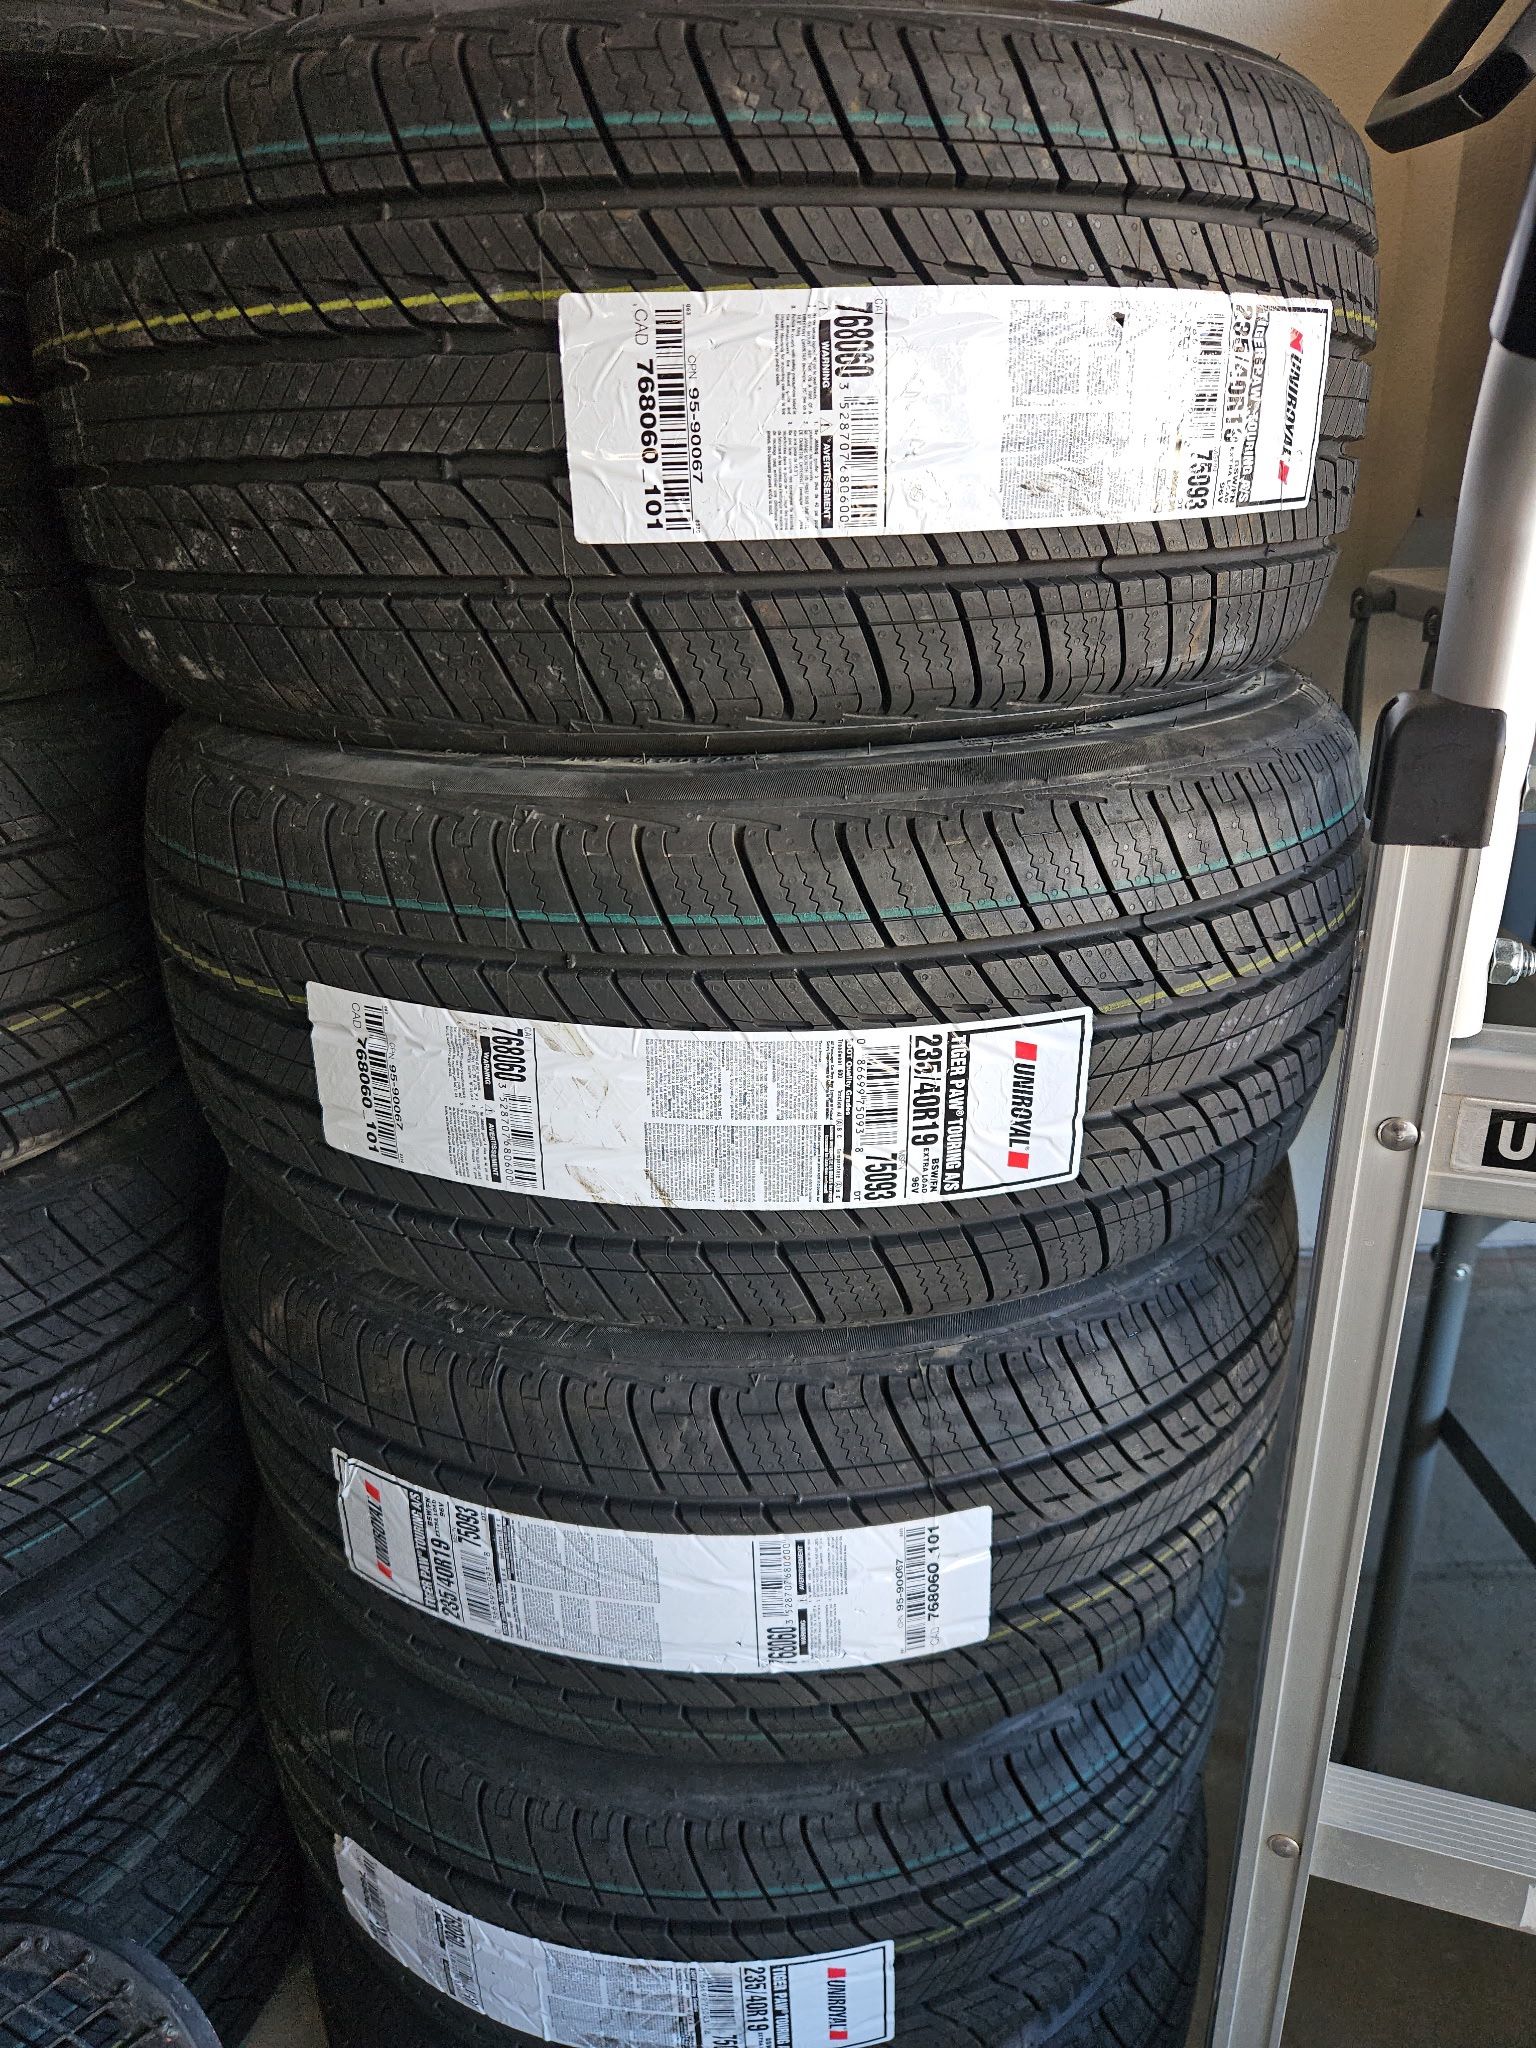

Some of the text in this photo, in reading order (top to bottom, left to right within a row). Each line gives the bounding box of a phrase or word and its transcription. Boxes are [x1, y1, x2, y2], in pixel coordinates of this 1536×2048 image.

[634, 308, 649, 346] CAD
[833, 302, 875, 377] 768060
[821, 341, 830, 389] WARNING
[839, 382, 848, 390] 3
[687, 355, 704, 484] CPN 95-90067
[1281, 353, 1303, 457] UNIROYAL
[822, 443, 831, 520] AVERTISSEMENT
[1186, 450, 1213, 510] 75093
[351, 1003, 362, 1028] CAD
[483, 1052, 491, 1085] WARNING
[491, 1026, 527, 1083] 768060
[950, 1032, 967, 1076] TIGER
[389, 1065, 404, 1131] 95-90067
[911, 1034, 943, 1146] 235/40R19
[1008, 1063, 1036, 1148] UNIROYAL
[488, 1123, 499, 1176] AVERTISSEMENT
[946, 1119, 963, 1169] TOURING
[853, 1191, 861, 1201] DT
[864, 1152, 898, 1201] 75093
[911, 1177, 919, 1194] 96V
[930, 1158, 940, 1192] BSW/FN
[943, 1172, 958, 1191] A/S
[409, 1492, 423, 1508] A/S
[438, 1502, 446, 1517] 96V
[367, 1500, 390, 1566] UNIROYAL
[412, 1509, 427, 1550] TOURING
[455, 1506, 482, 1548] 75093
[431, 1538, 461, 1619] 235/40R19
[797, 1545, 805, 1590] AVERTISSEMENT
[896, 1558, 904, 1611] 95-90067
[766, 1627, 797, 1665] 768060
[930, 1626, 940, 1646] CAD
[744, 1967, 769, 2031] 235/40R19
[772, 1966, 786, 1992] TIGER
[827, 1979, 846, 2029] UNIROYAL
[775, 2014, 790, 2045] TOURING
